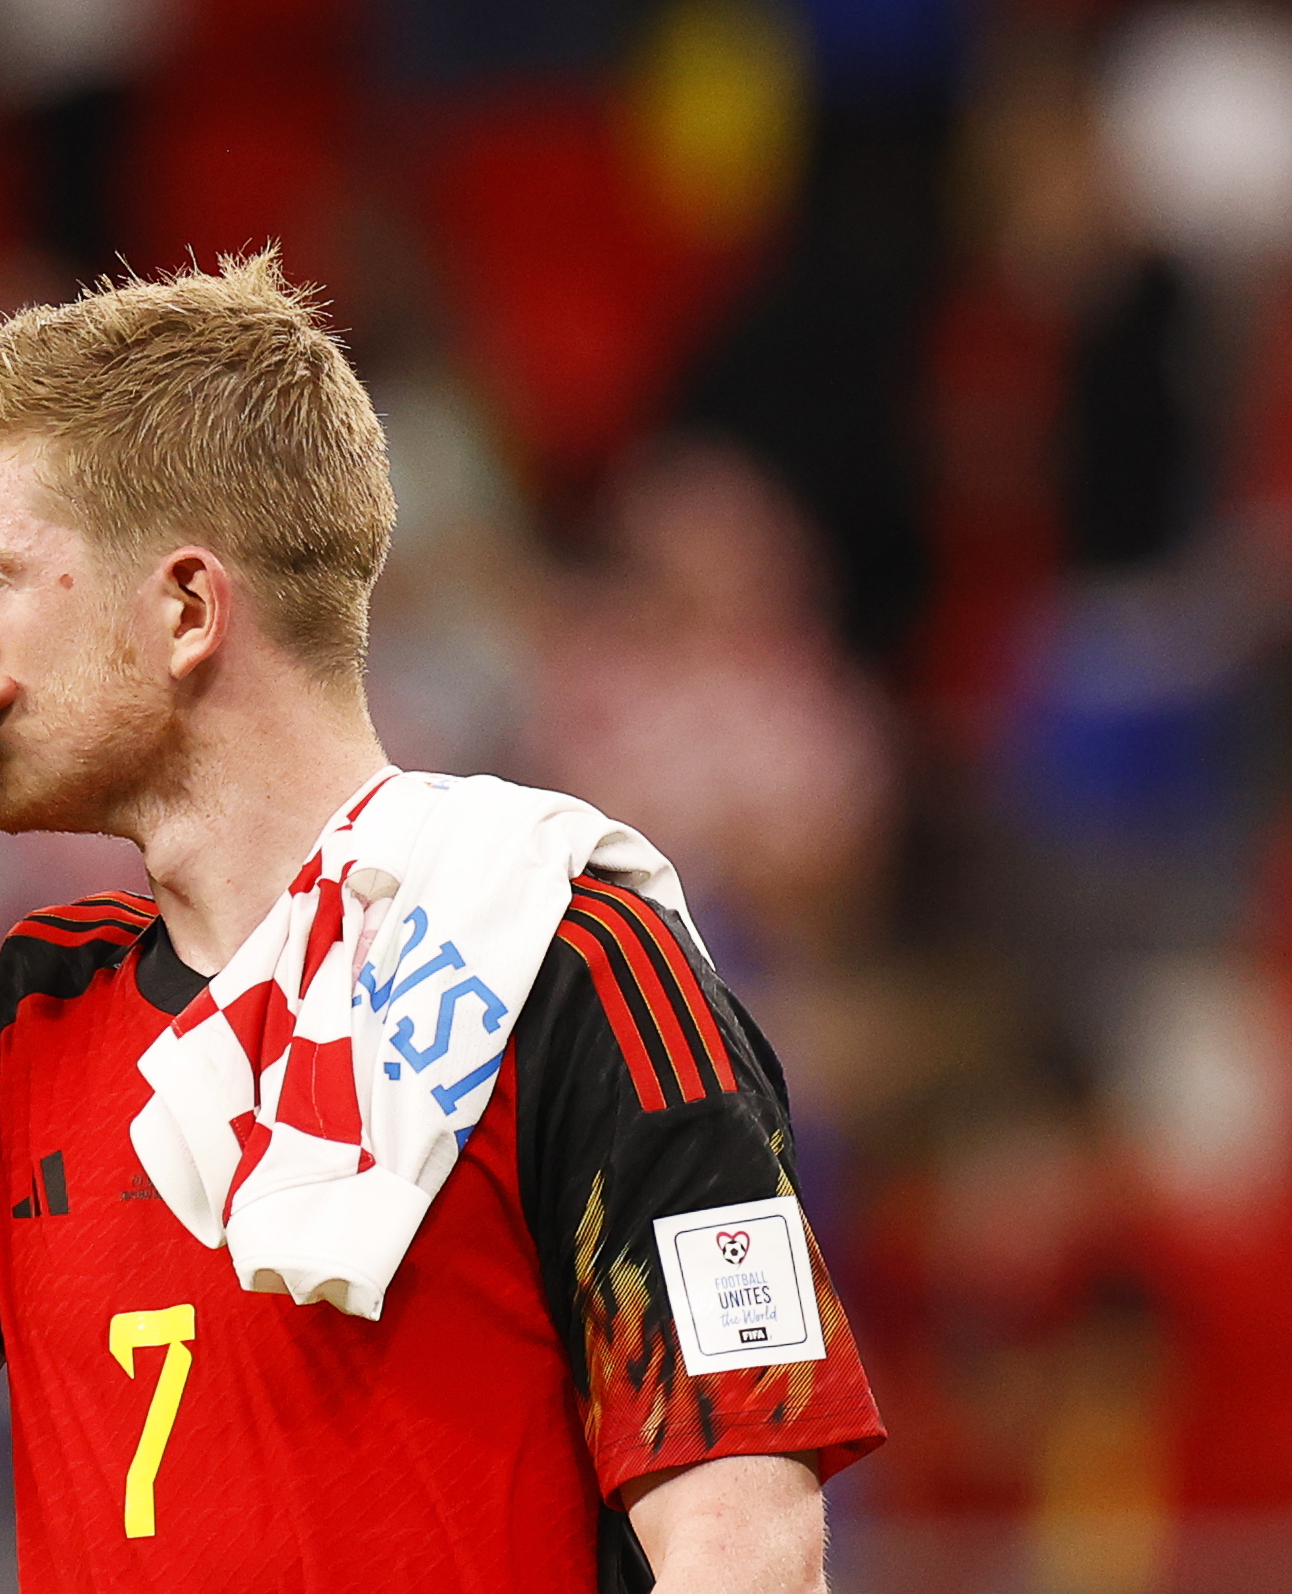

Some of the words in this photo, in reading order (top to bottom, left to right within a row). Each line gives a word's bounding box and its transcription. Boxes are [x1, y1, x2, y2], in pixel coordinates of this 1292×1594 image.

[715, 1271, 768, 1291] FOOTBALL
[718, 1285, 772, 1310] UNITES
[720, 1311, 740, 1328] the
[742, 1305, 778, 1324] World
[741, 1329, 766, 1341] FIFA
[109, 1304, 196, 1538] 7
